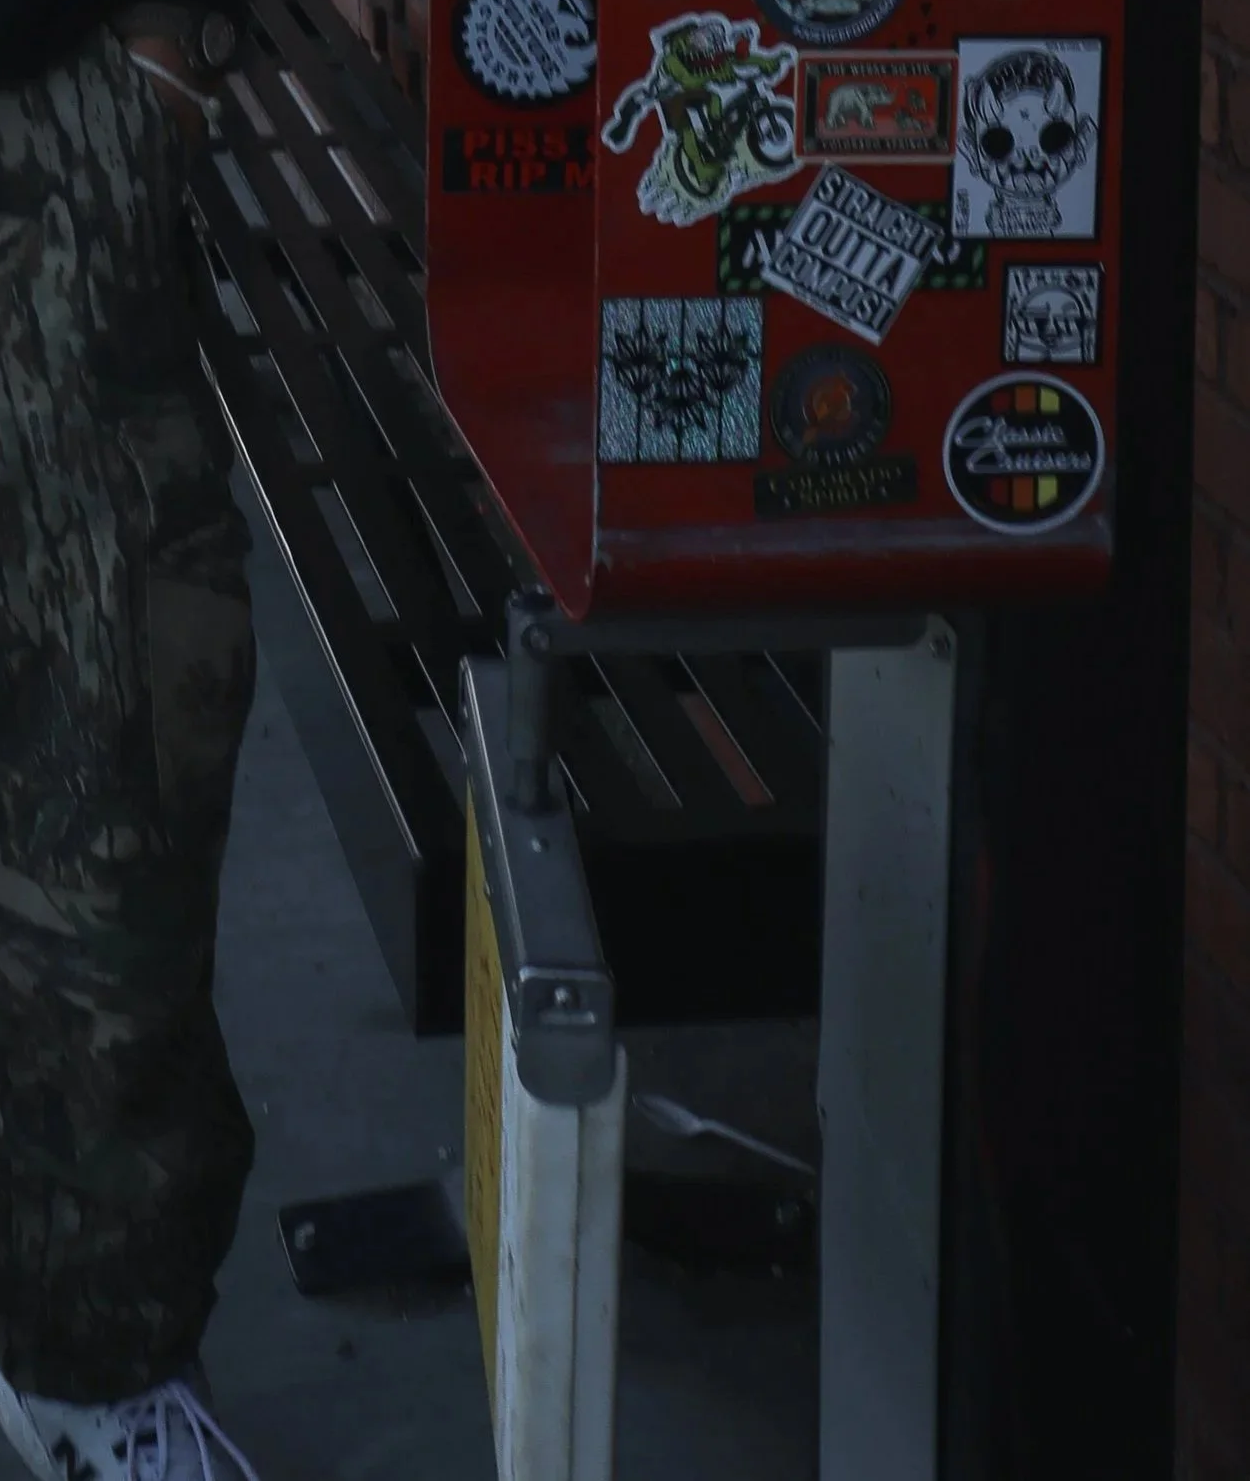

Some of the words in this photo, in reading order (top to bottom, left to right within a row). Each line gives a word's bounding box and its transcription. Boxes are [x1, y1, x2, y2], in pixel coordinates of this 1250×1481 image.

[463, 129, 569, 160] PISS
[469, 161, 547, 191] RIP
[813, 172, 937, 259] STRAIGHT
[801, 209, 897, 291] OUTTA
[774, 244, 896, 331] COMPOST
[953, 415, 1068, 449] Classic
